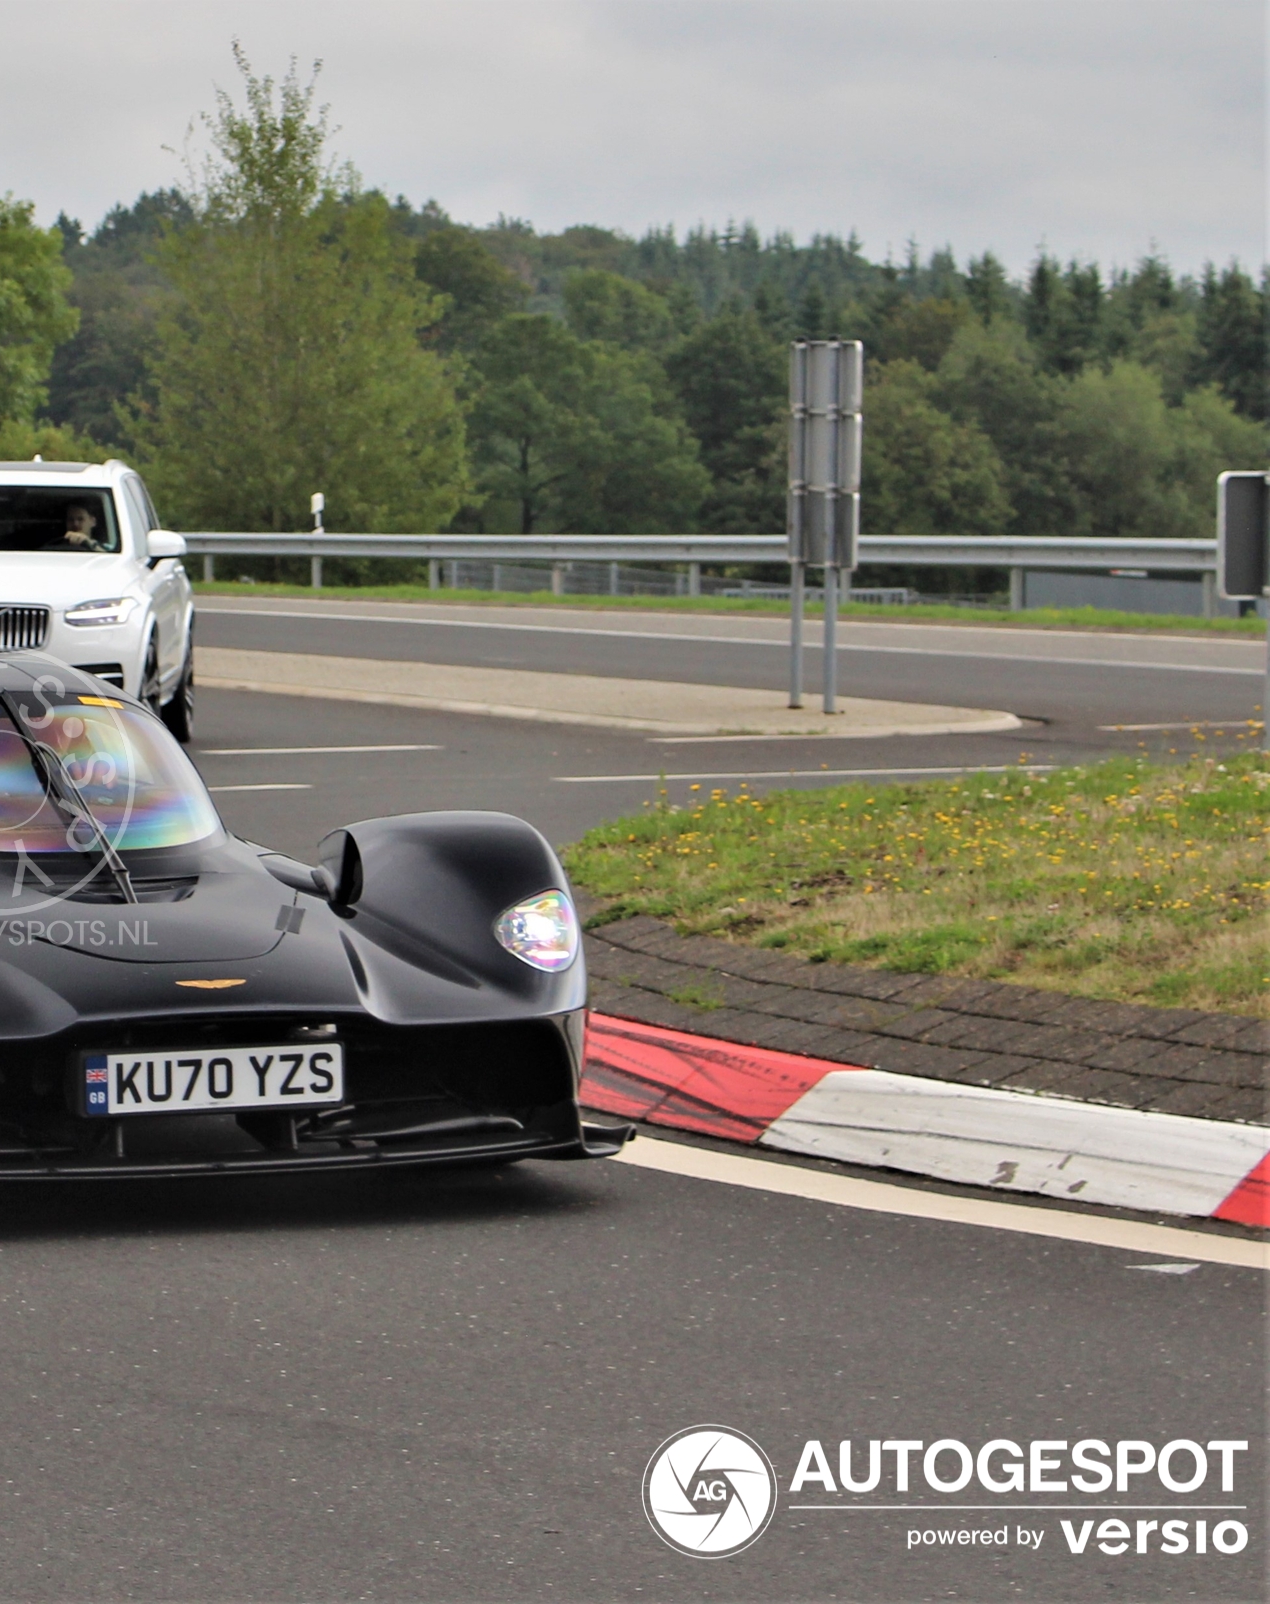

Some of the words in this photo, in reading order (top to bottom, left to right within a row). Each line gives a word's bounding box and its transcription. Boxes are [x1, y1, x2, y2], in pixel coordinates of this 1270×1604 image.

[116, 1057, 234, 1105] KU70
[249, 1051, 334, 1097] YZS
[89, 1091, 106, 1104] GB
